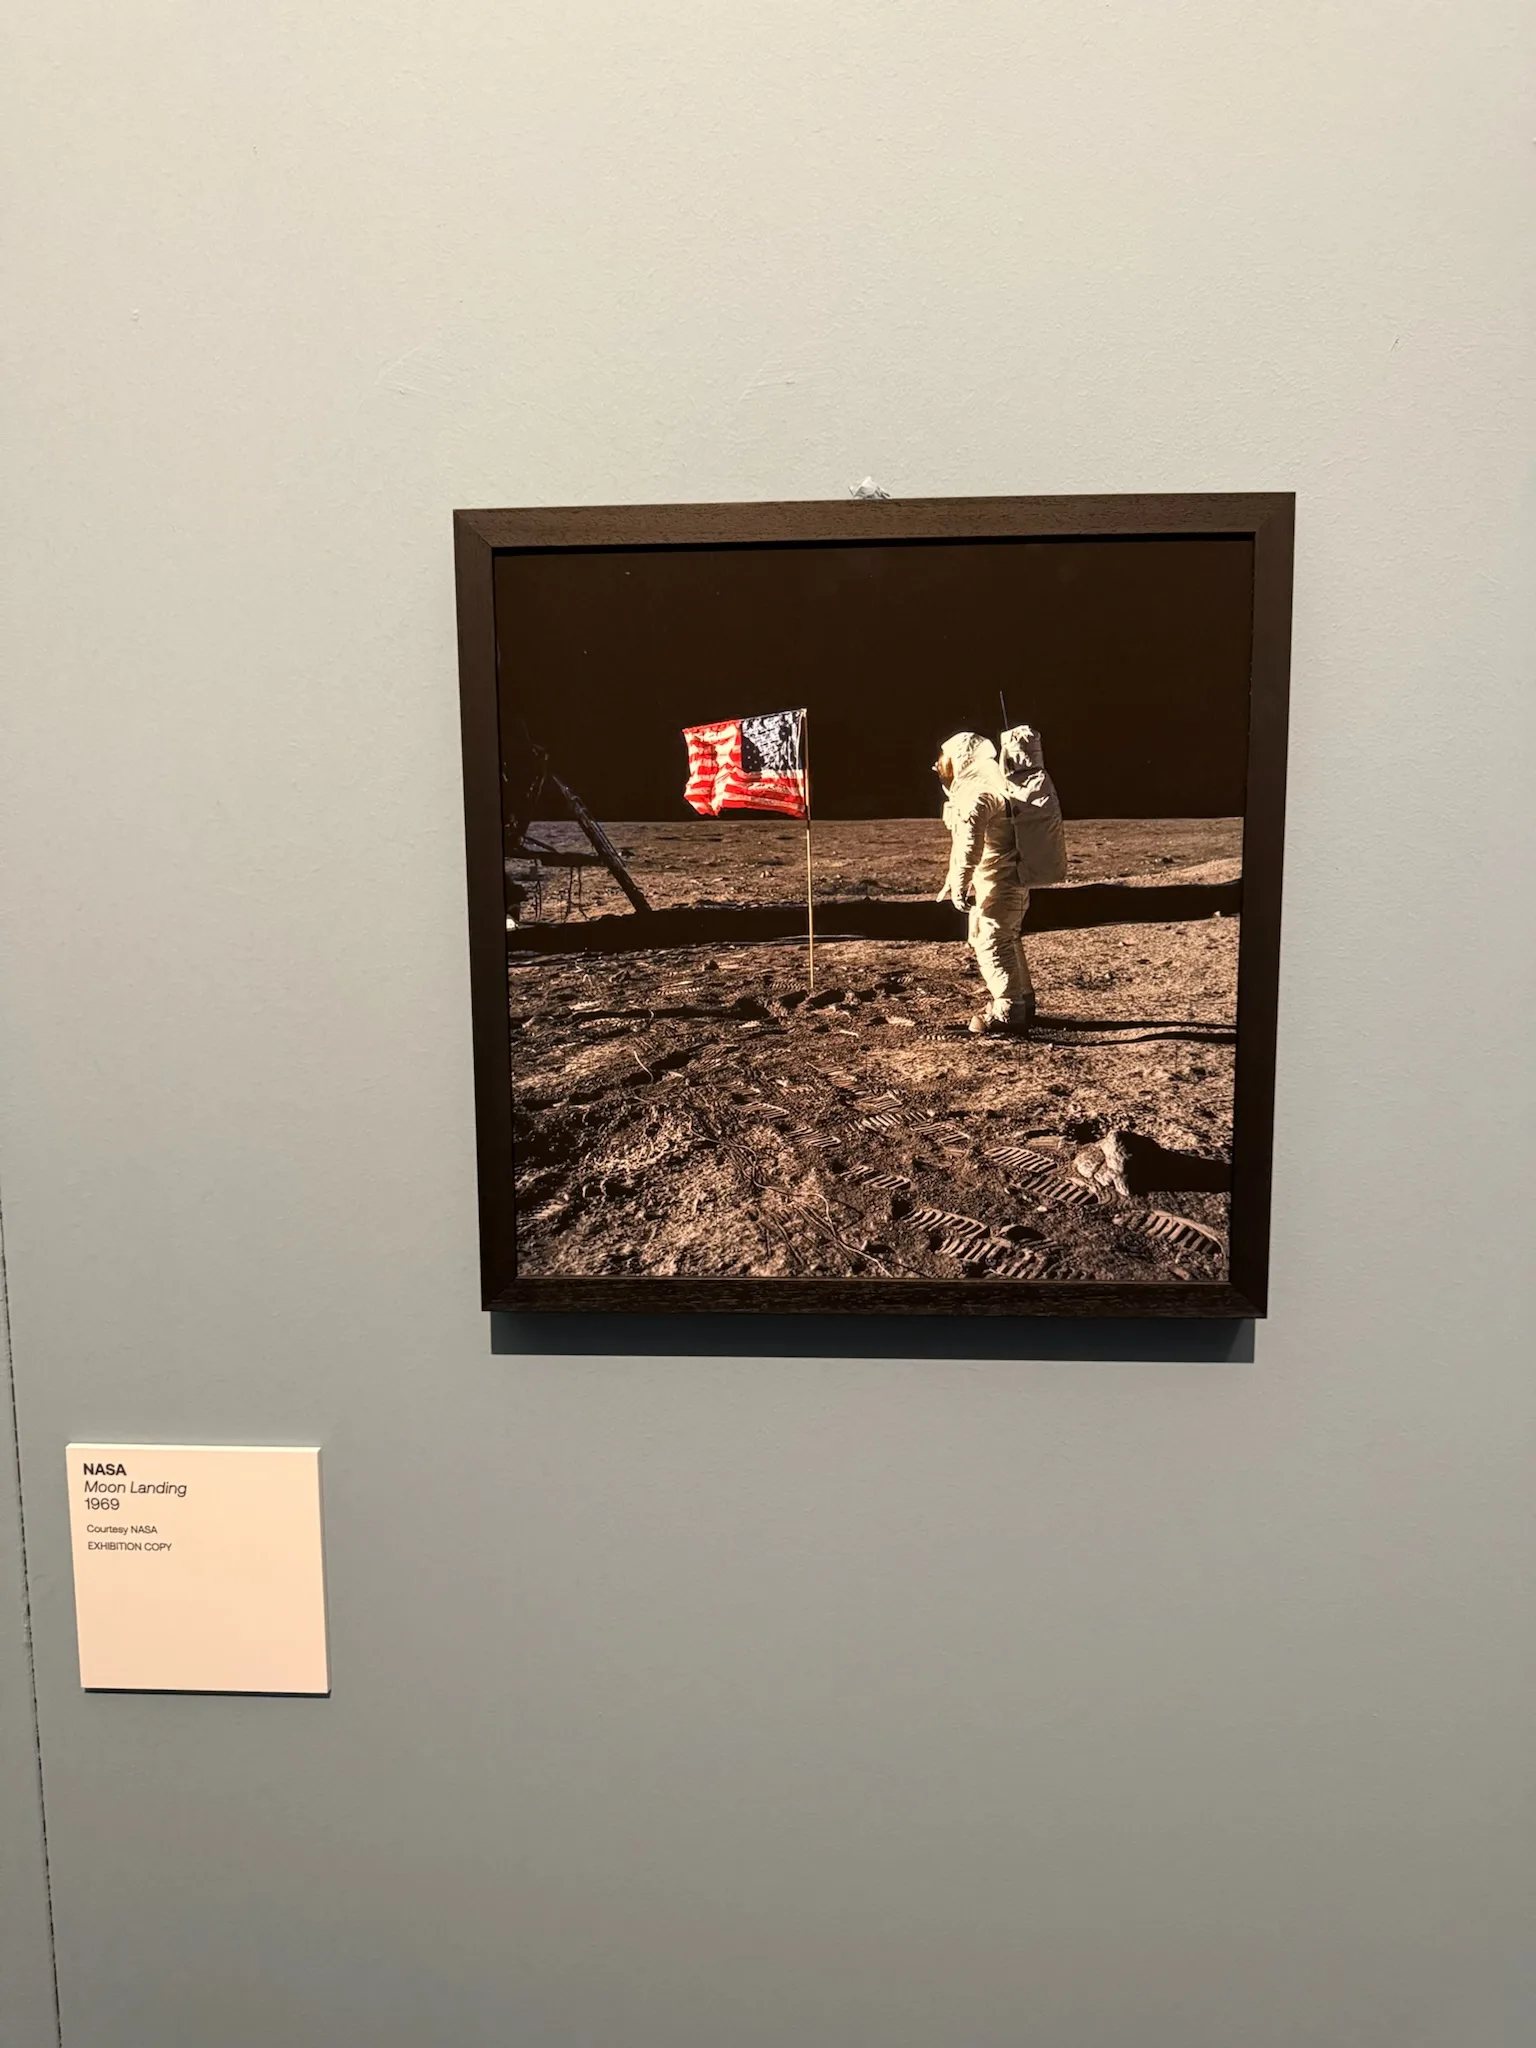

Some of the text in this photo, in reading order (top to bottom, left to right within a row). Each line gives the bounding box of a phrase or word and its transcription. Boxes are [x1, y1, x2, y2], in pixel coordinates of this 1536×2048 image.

[83, 1463, 127, 1476] NASA
[84, 1480, 187, 1498] Moon Landing
[84, 1497, 120, 1510] 1969
[86, 1524, 158, 1535] Courtesy NASA
[87, 1541, 172, 1551] EXHIBITION COPY
